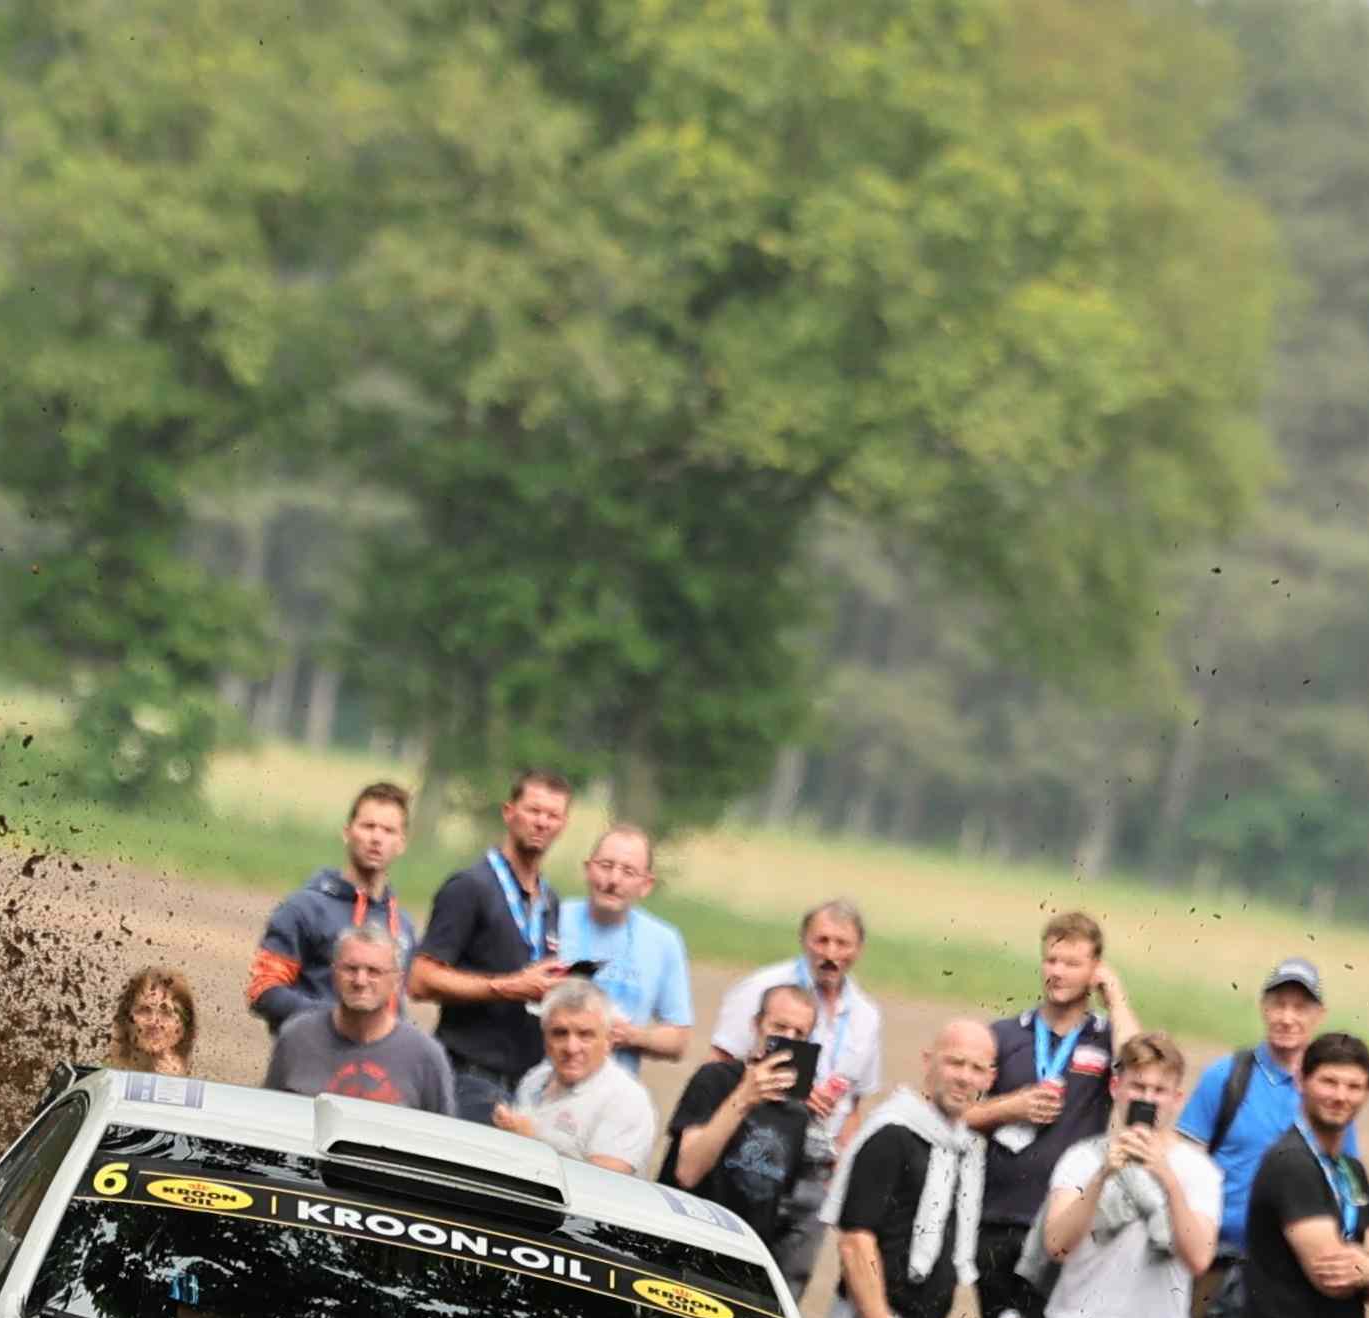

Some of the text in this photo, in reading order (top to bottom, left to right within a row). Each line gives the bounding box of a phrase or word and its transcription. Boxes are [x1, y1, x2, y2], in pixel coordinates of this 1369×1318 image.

[93, 1162, 129, 1195] 6
[162, 1187, 237, 1202] KROON
[182, 1196, 215, 1207] OIL
[297, 1200, 591, 1283] KROON-OIL
[647, 1286, 719, 1314] KROON
[667, 1300, 699, 1315] OIL
